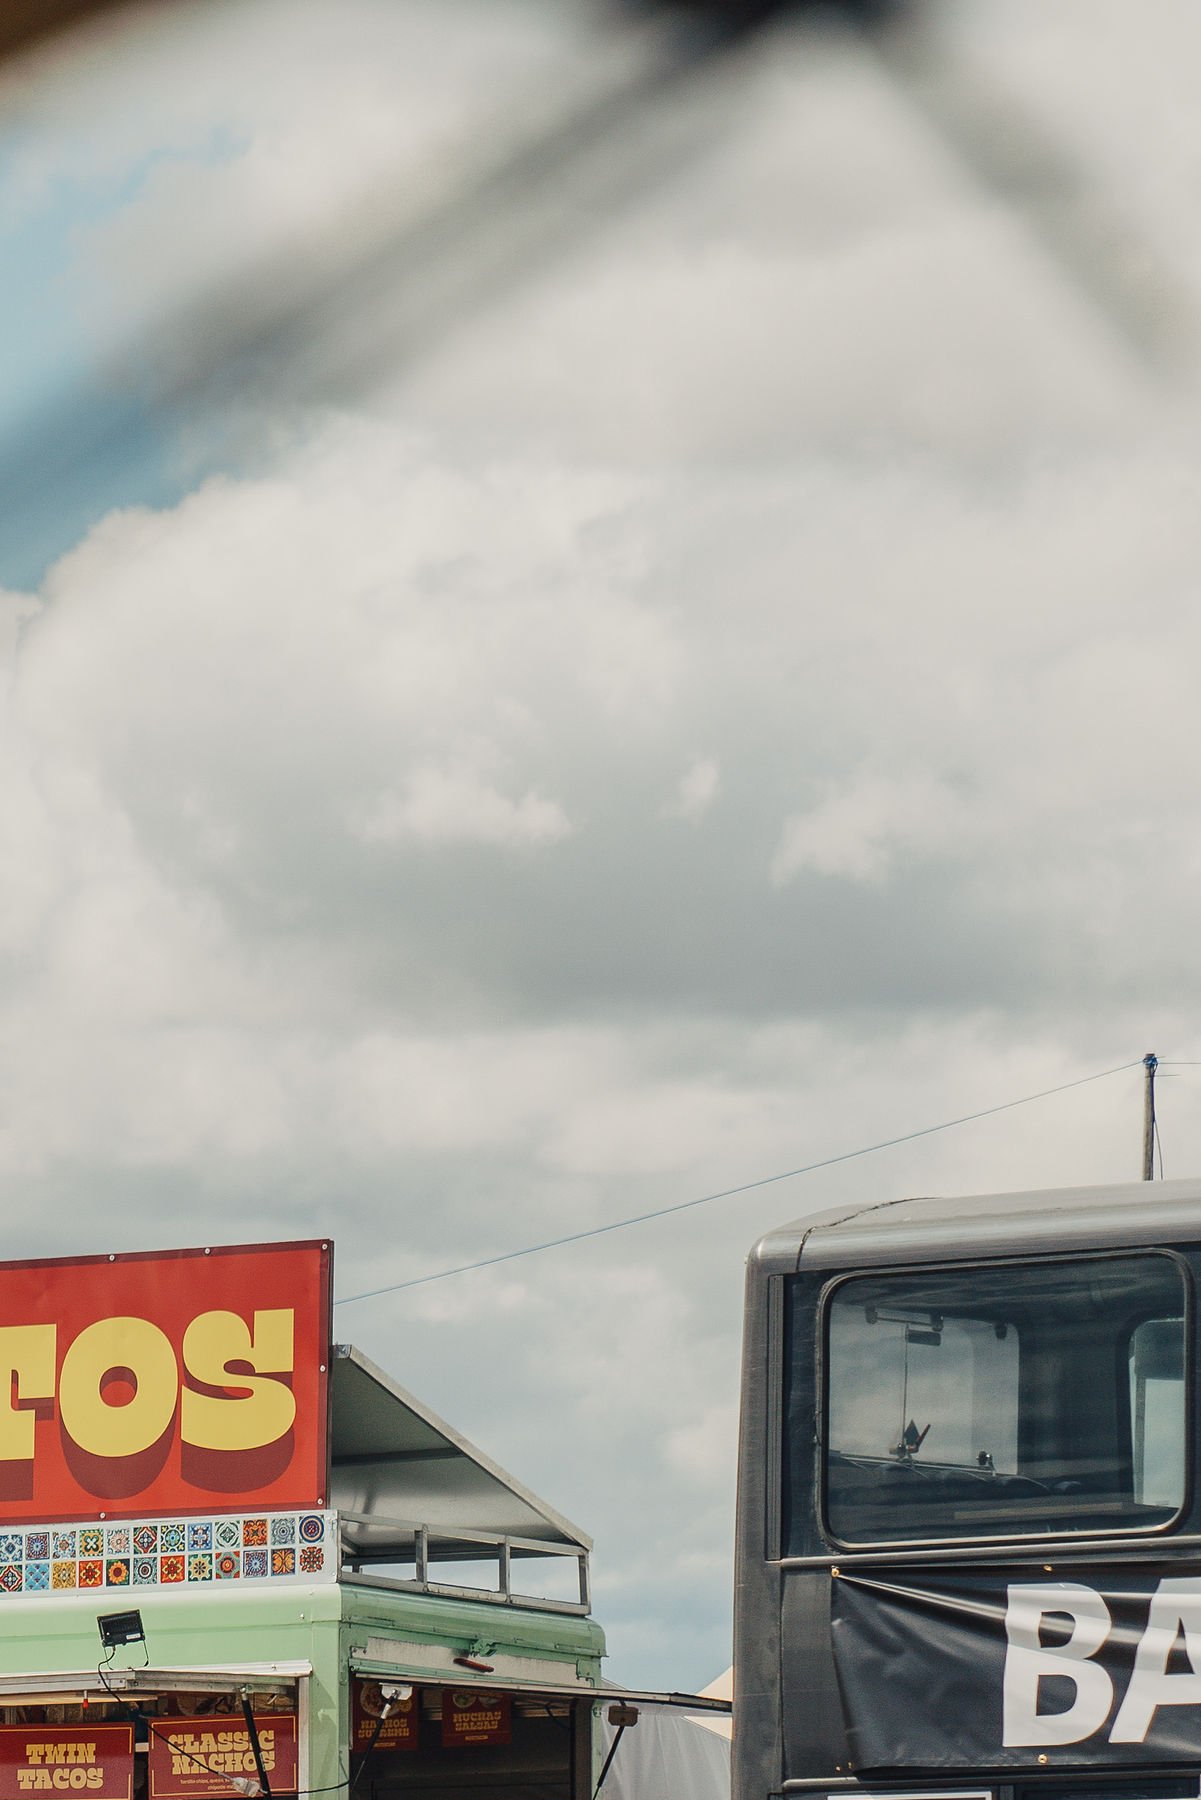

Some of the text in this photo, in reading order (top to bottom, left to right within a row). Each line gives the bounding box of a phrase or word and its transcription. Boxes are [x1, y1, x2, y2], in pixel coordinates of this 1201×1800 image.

[26, 1743, 96, 1765] TWIN
[172, 1750, 276, 1775] NACHOS
[17, 1767, 104, 1790] TACOS
